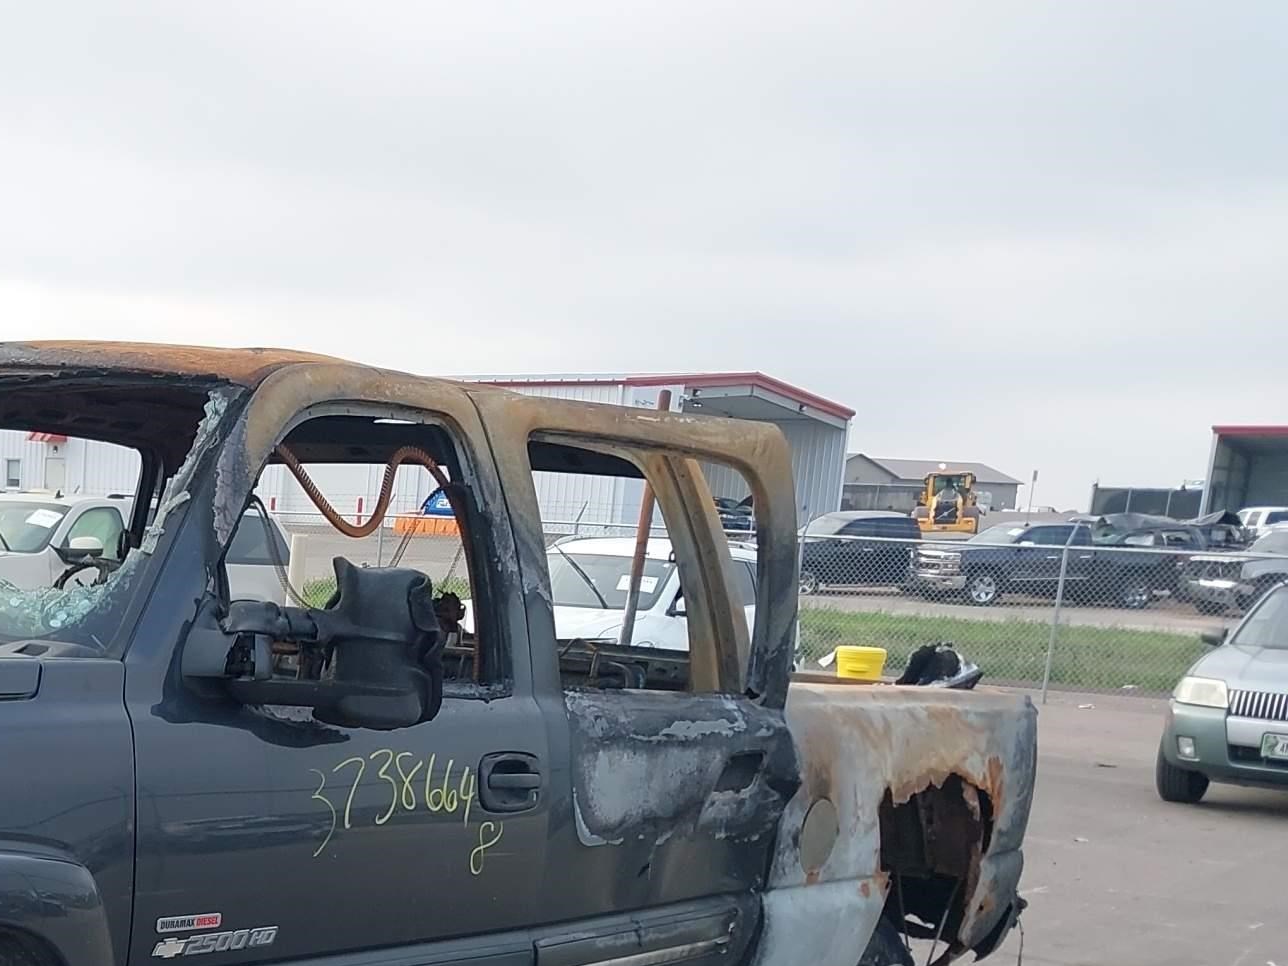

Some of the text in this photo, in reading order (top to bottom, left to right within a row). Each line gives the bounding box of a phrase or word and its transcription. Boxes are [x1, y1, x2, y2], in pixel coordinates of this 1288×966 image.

[309, 749, 475, 857] 3738664
[470, 821, 503, 875] 8
[160, 915, 218, 930] DURAMAX DIESEL
